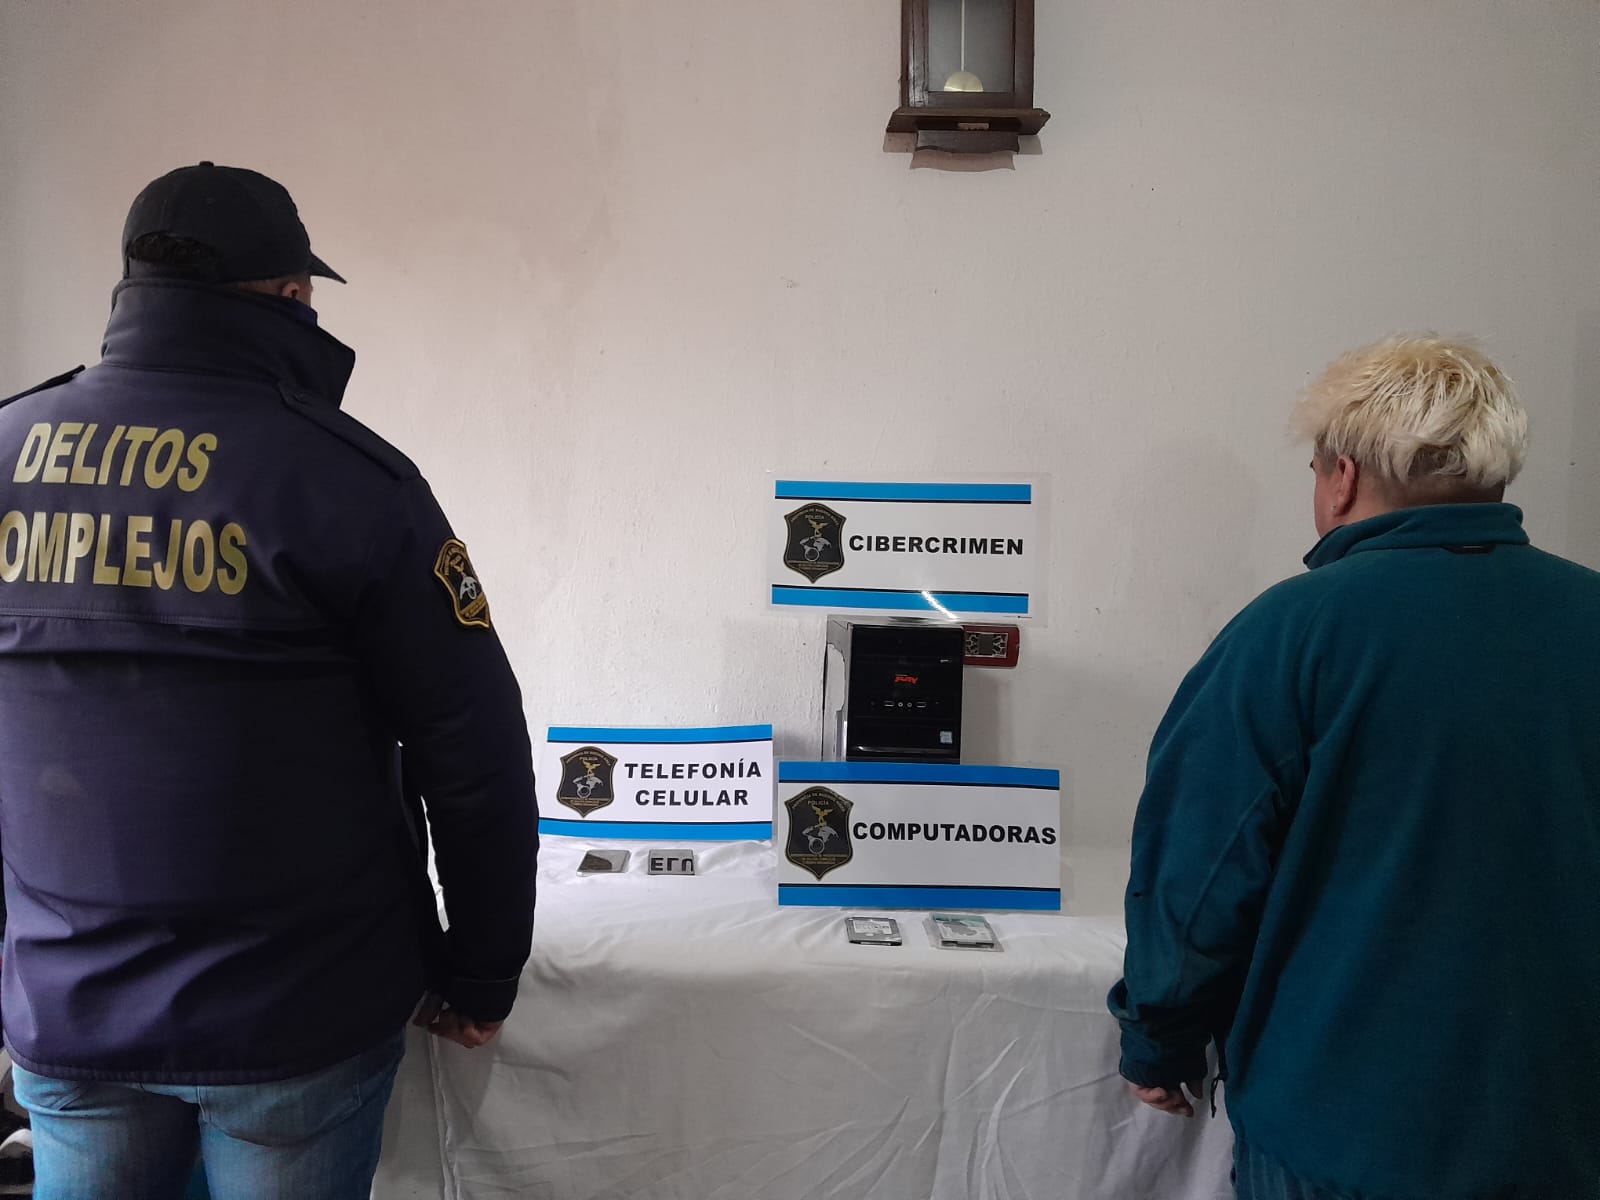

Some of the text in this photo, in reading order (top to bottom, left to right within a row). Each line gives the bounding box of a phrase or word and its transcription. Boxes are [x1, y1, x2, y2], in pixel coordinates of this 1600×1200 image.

[12, 422, 217, 492] DELITOS
[849, 535, 1023, 555] CIBERCRIMEN
[624, 758, 762, 779] TELEFONÍA
[635, 789, 748, 806] CELULAR
[853, 822, 1057, 845] COMPUTADORAS
